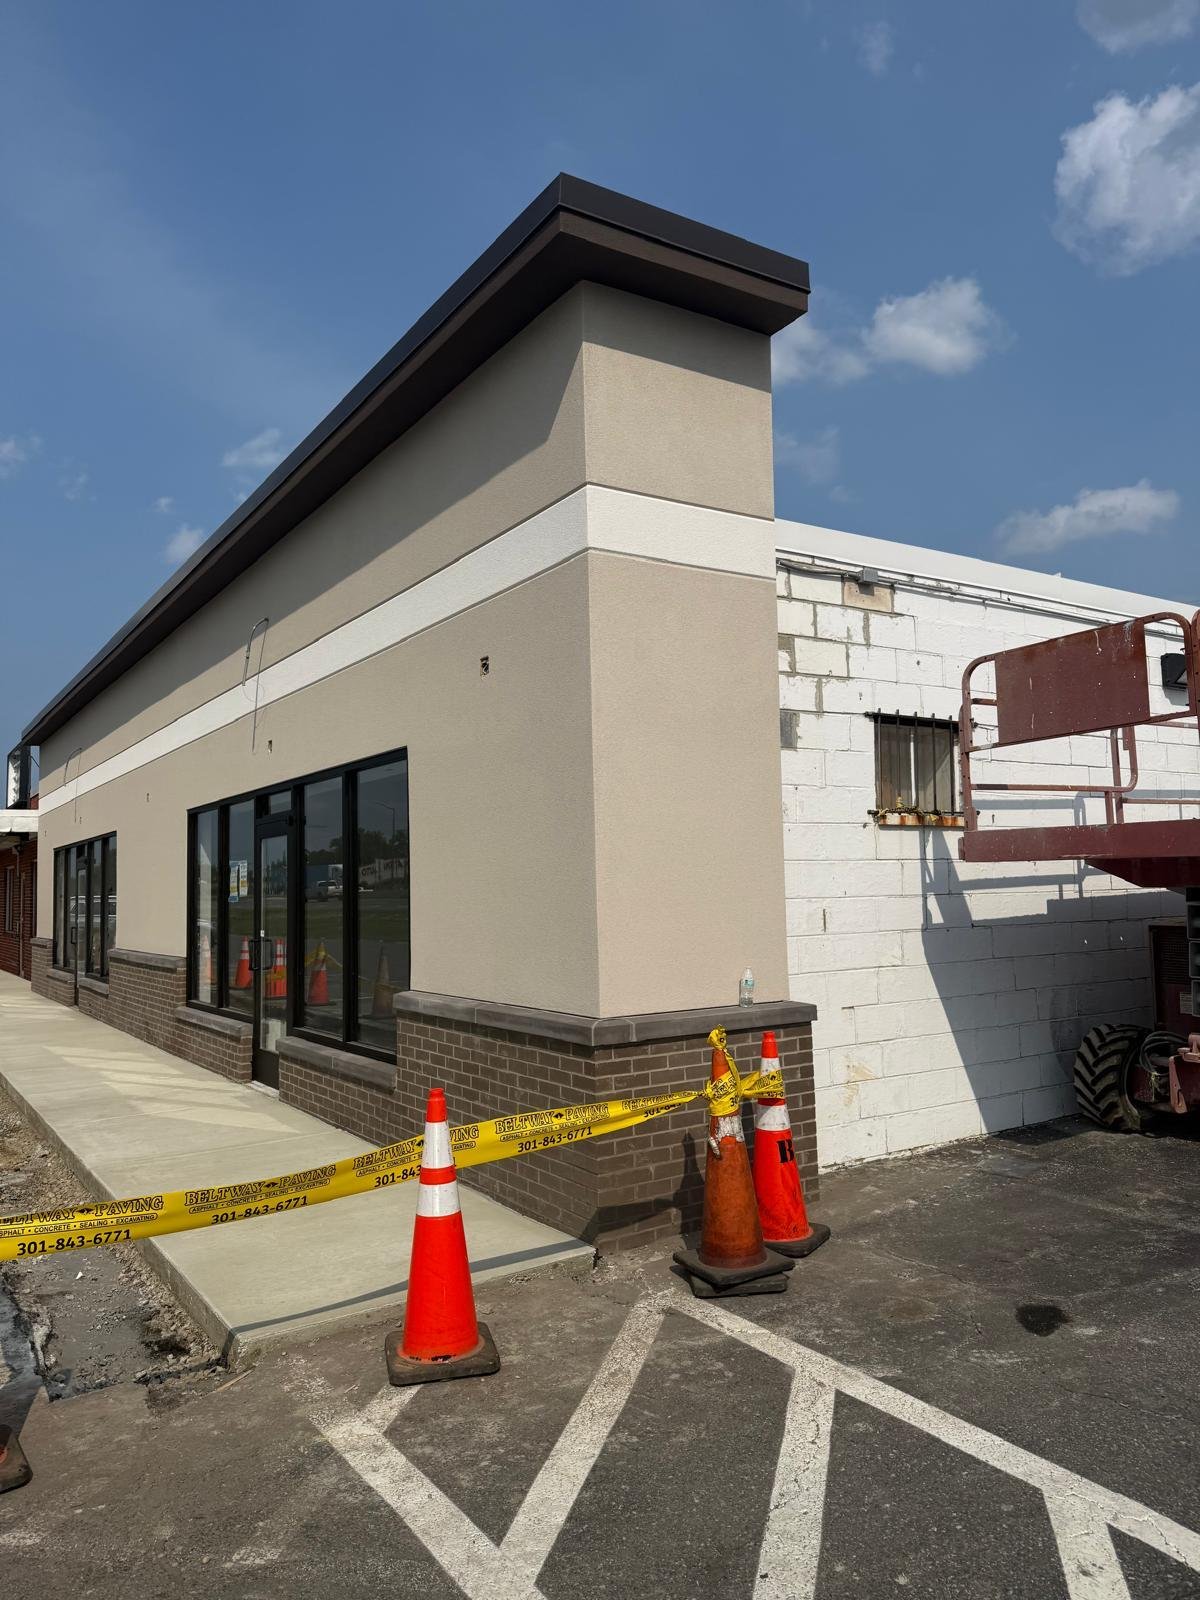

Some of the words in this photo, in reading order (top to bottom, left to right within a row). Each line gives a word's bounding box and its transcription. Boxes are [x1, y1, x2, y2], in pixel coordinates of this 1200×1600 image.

[495, 1111, 554, 1134] BELTWAY
[565, 1103, 610, 1120] PAVING
[352, 1139, 417, 1170] BELTWAY
[450, 1125, 479, 1142] VING
[517, 1126, 592, 1152] 301-843-6771
[184, 1181, 265, 1206] BELTWAY
[279, 1164, 336, 1188] PAVING
[0, 1207, 77, 1225] LTWAY
[95, 1195, 164, 1216] PAVING
[211, 1196, 308, 1225] 301-843-6771
[0, 1228, 25, 1237] SPHALT
[34, 1224, 71, 1233] CONCRETE
[79, 1220, 108, 1228] SEALING
[116, 1214, 156, 1224] EXCAVATING
[17, 1229, 131, 1256] 301-843-6771
